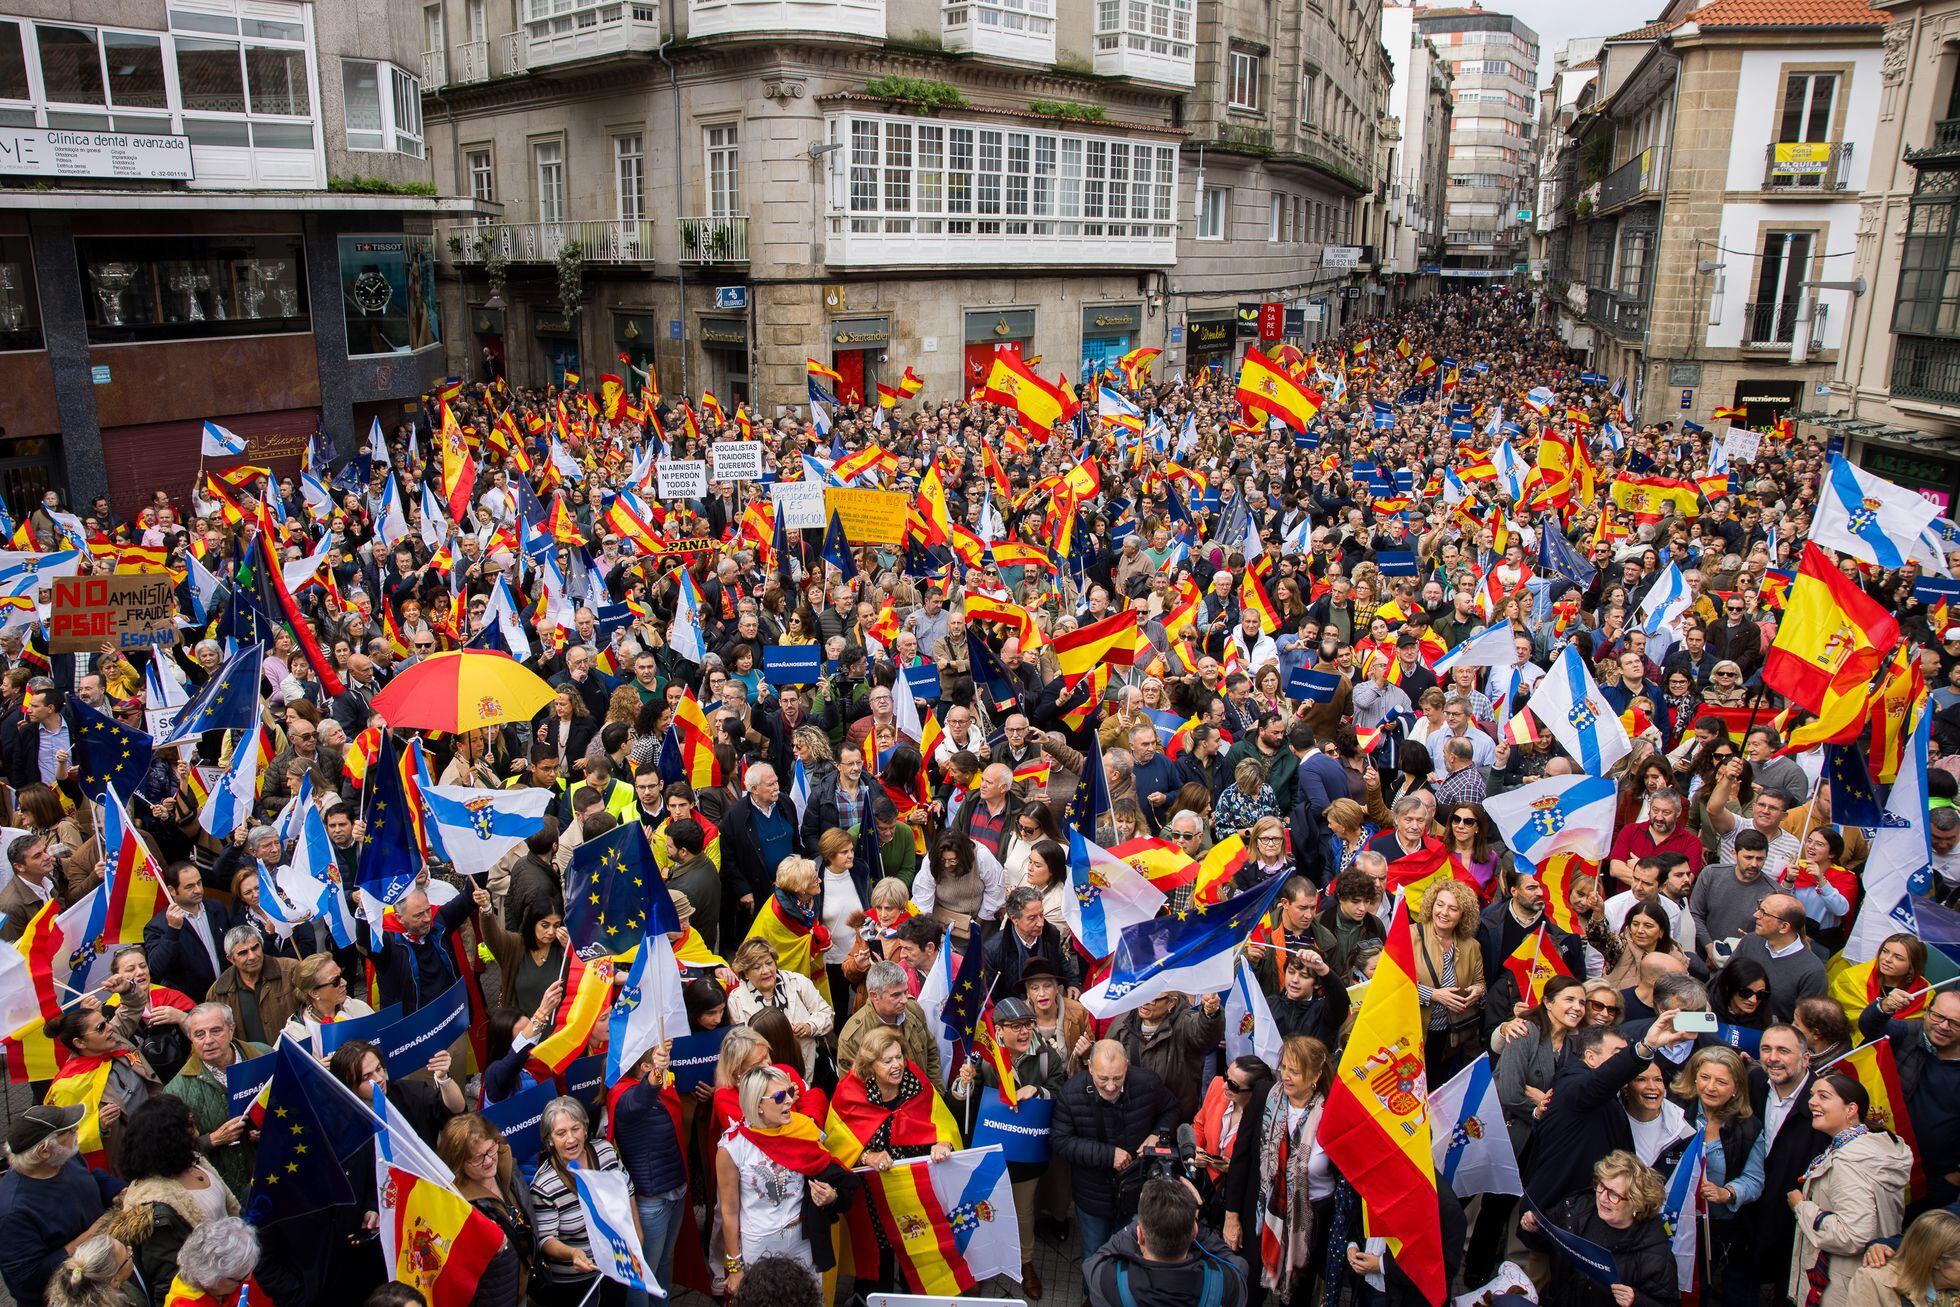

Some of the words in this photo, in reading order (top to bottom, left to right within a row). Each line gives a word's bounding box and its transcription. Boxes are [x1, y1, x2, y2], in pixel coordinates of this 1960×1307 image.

[47, 132, 90, 146] Clínica
[94, 134, 128, 147] dental
[132, 137, 184, 149] avanzada
[371, 243, 402, 251] TISSOT
[1267, 305, 1276, 313] PA
[1267, 313, 1276, 321] SA
[849, 329, 889, 342] Santander
[715, 444, 758, 453] SOCIALISTAS
[718, 452, 756, 461] TRAIDORES
[668, 462, 702, 471] AMNISTÍA
[718, 461, 756, 470] QUEREMOS
[670, 471, 700, 479] PERDÓN
[717, 470, 758, 478] ELECCIONES
[667, 489, 696, 497] PRISIÓN
[772, 492, 821, 501] PRESIDENCIA
[789, 501, 804, 510] ES
[54, 580, 108, 608] NO
[53, 611, 117, 637] PSOE
[126, 604, 171, 620] FRAUDE
[142, 621, 153, 631] A
[120, 627, 175, 648] ESPAÑA
[388, 1002, 465, 1060] #ESPAÑANOSERINDE
